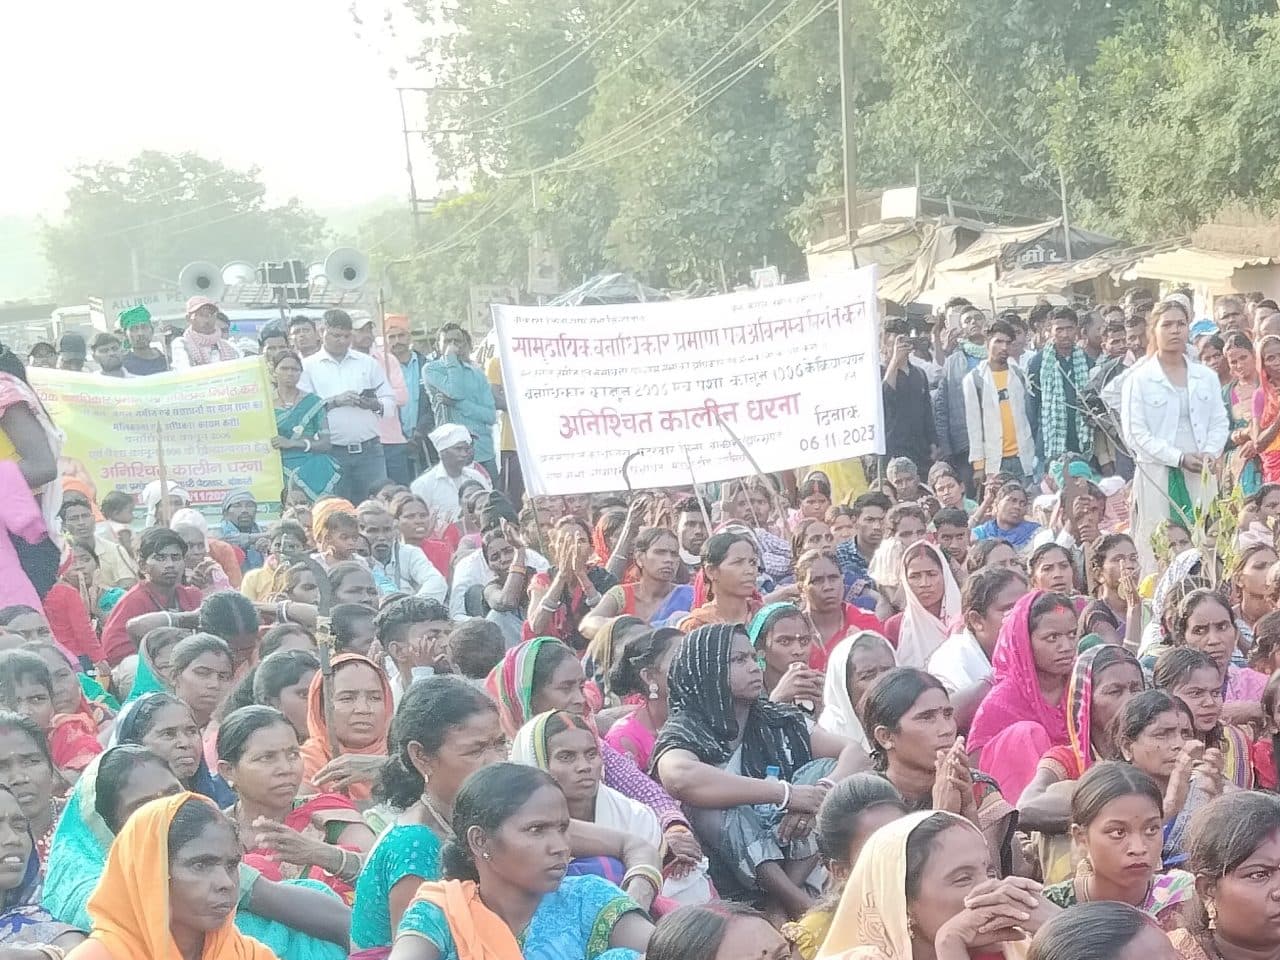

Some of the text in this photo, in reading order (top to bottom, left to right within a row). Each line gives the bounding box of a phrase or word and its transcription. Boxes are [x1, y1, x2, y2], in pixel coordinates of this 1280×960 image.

[559, 393, 802, 439] अनिश्चित कालीन धरना
[172, 459, 223, 477] कालीन
[227, 459, 263, 474] धरना
